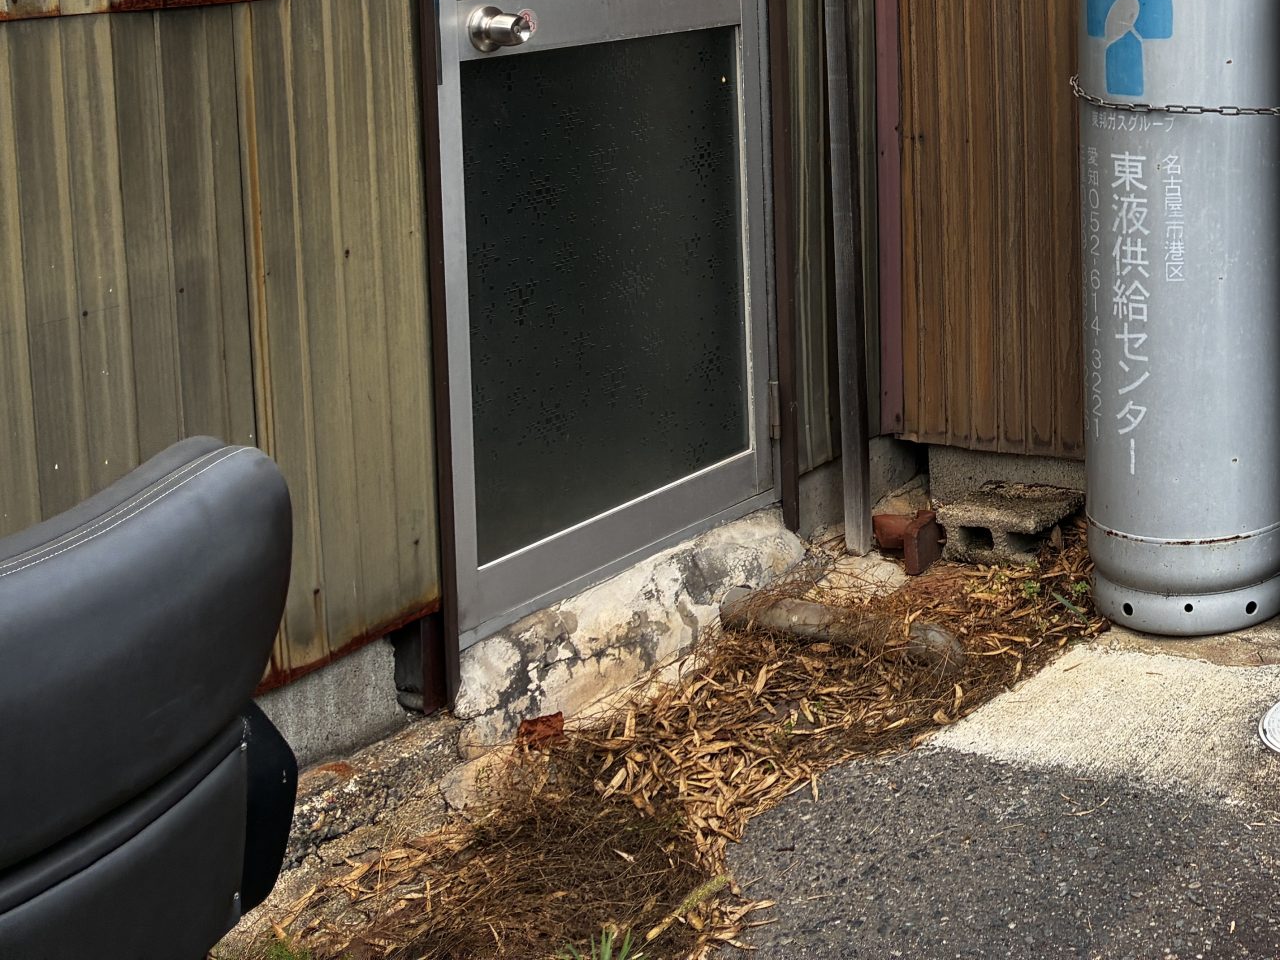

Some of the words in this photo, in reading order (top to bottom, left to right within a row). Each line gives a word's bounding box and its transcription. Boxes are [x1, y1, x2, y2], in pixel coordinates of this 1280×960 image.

[1111, 151, 1151, 476] 東液供給センター
[1162, 153, 1185, 282] 名古屋市港区
